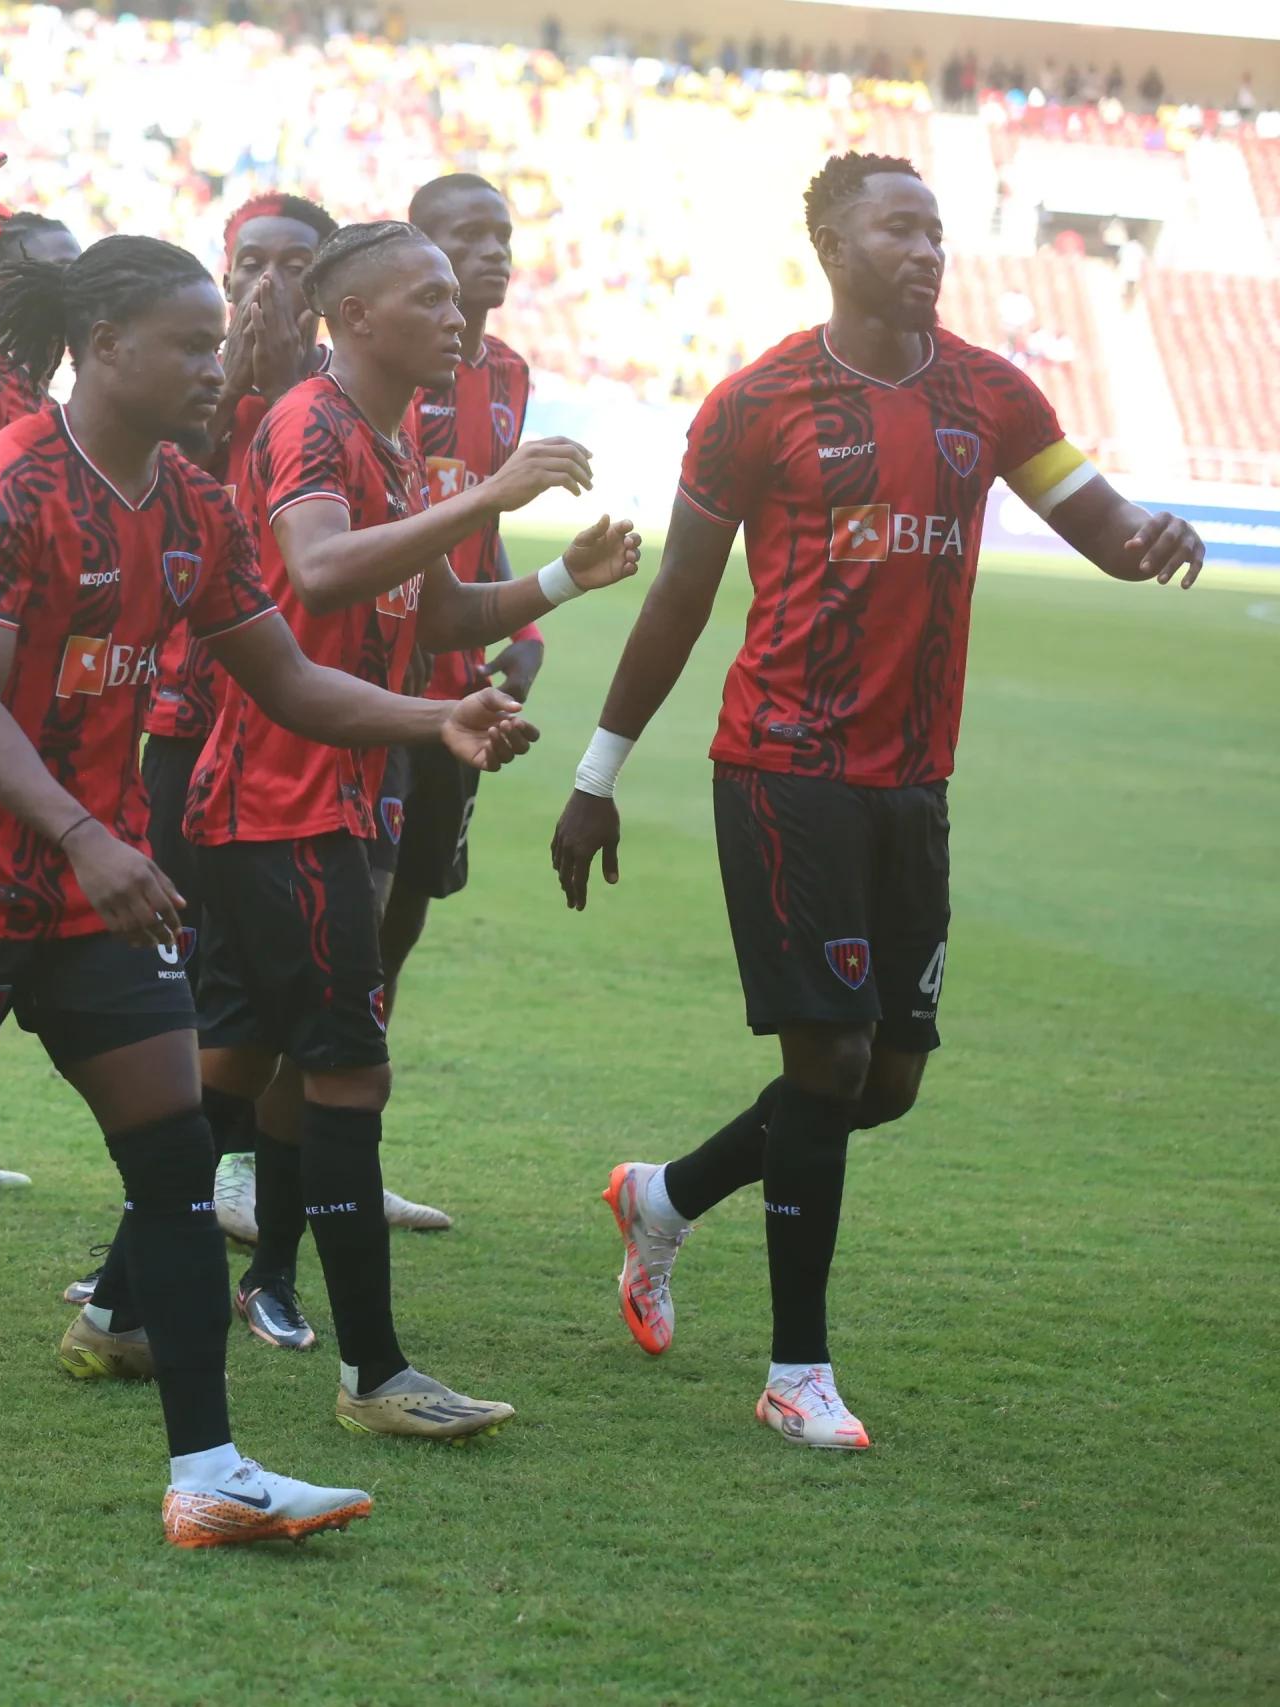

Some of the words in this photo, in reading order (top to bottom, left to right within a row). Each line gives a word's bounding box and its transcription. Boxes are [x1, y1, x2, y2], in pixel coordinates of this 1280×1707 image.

[891, 513, 964, 556] BFA
[106, 641, 158, 687] BFA
[918, 941, 946, 1004] 4
[305, 1202, 358, 1216] KELME
[765, 1201, 801, 1216] ELME
